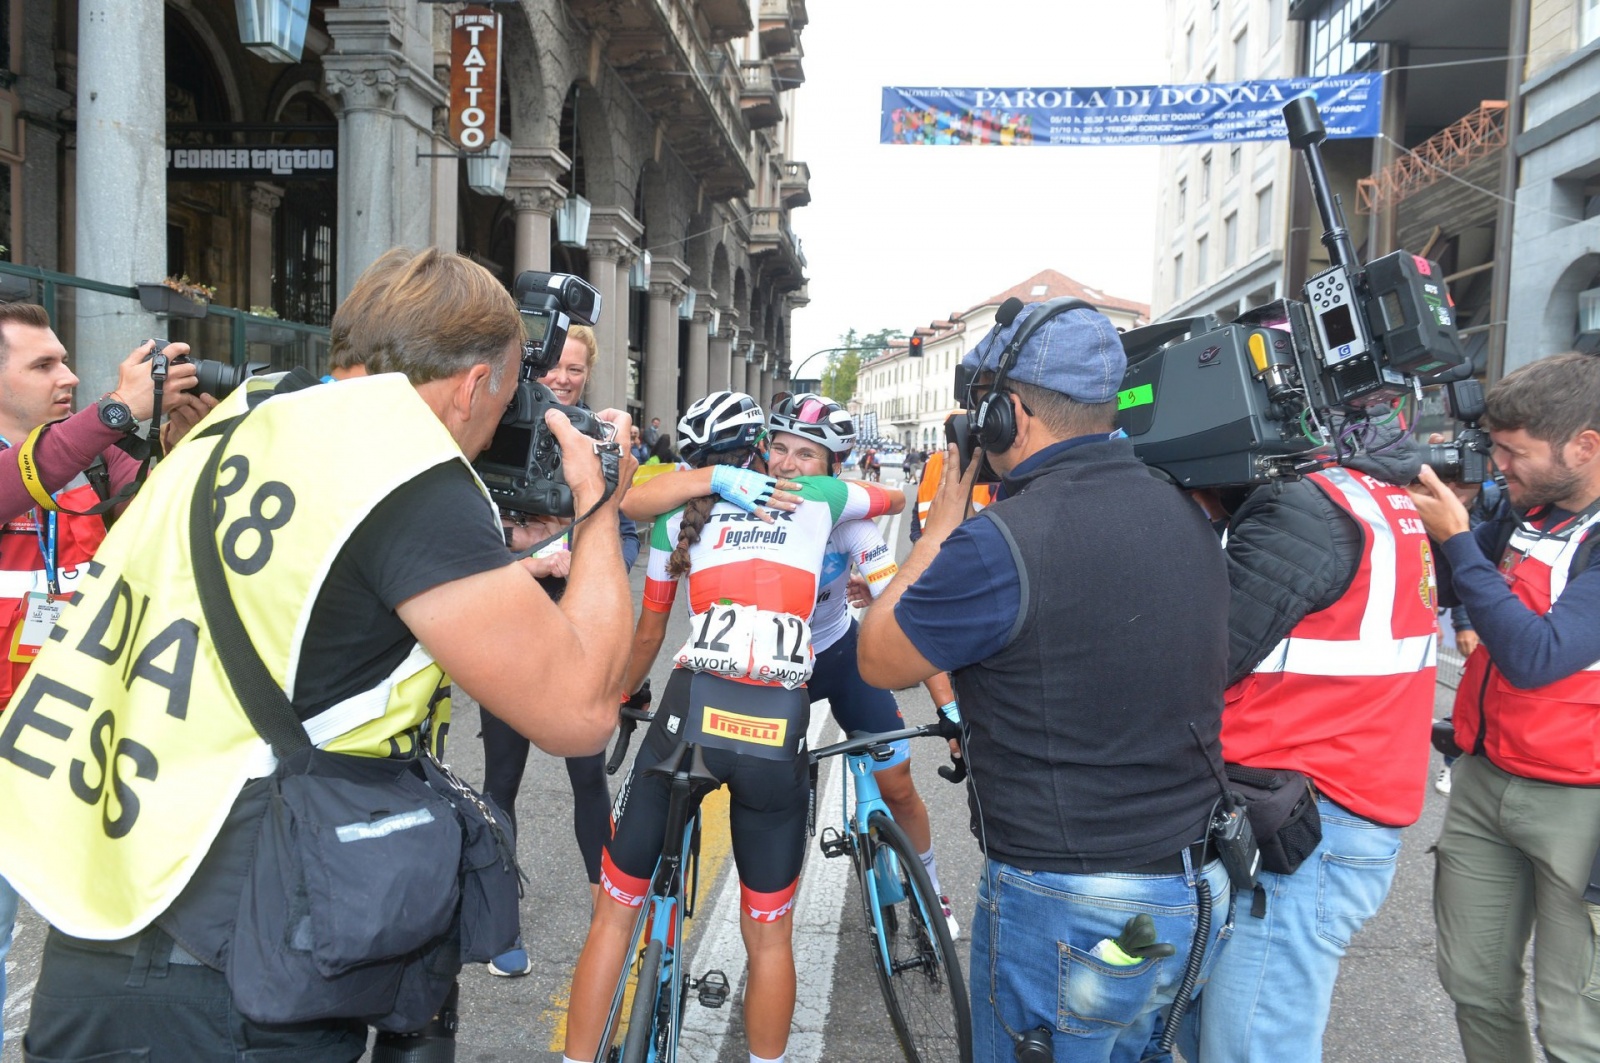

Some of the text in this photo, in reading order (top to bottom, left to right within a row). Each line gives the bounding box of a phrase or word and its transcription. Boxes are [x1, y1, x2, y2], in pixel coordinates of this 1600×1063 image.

[460, 26, 485, 148] TATTOO
[975, 84, 1285, 108] PAROLA DI DONNA
[23, 454, 33, 480] Nikon
[713, 526, 787, 549] Segafredo
[693, 606, 737, 653] 12
[772, 617, 805, 665] 12
[679, 654, 738, 671] e-work
[710, 713, 780, 740] PIRELLI
